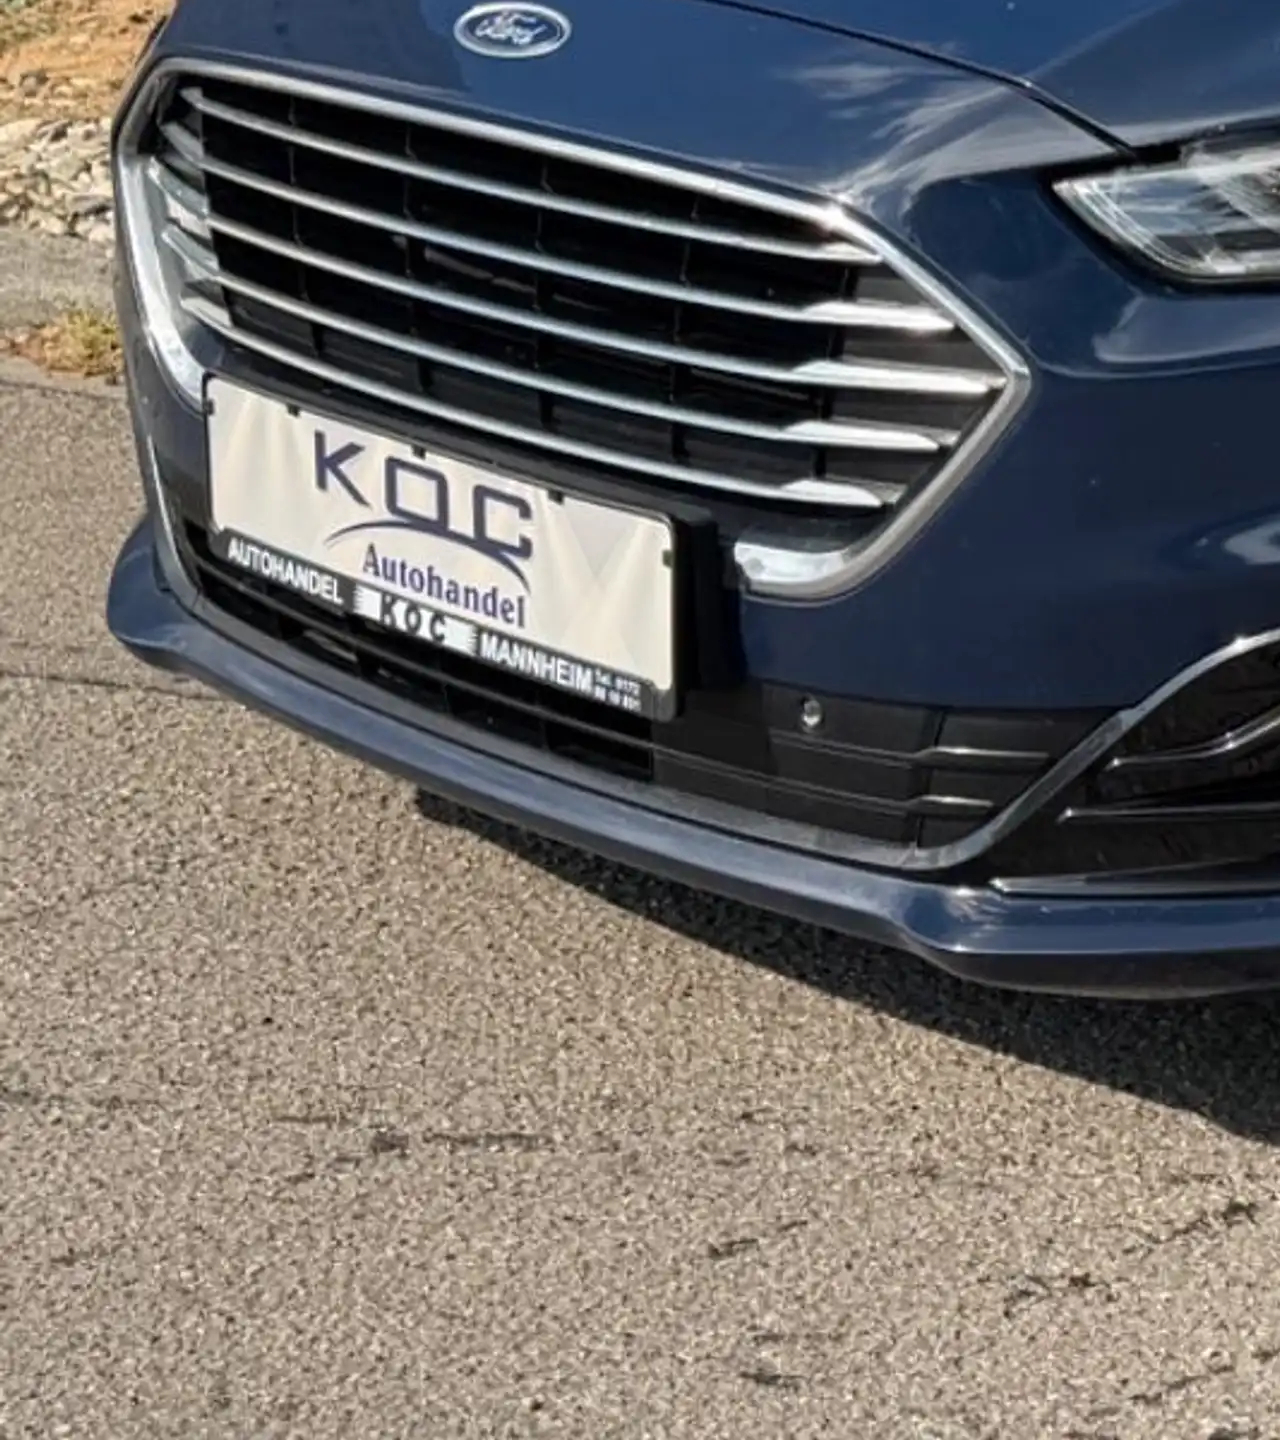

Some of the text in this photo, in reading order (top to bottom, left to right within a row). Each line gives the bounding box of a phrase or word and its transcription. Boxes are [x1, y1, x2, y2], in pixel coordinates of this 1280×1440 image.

[228, 537, 345, 605] AUTOHANDEL
[481, 632, 592, 694] MANNHEIM
[362, 542, 526, 628] Autohandel
